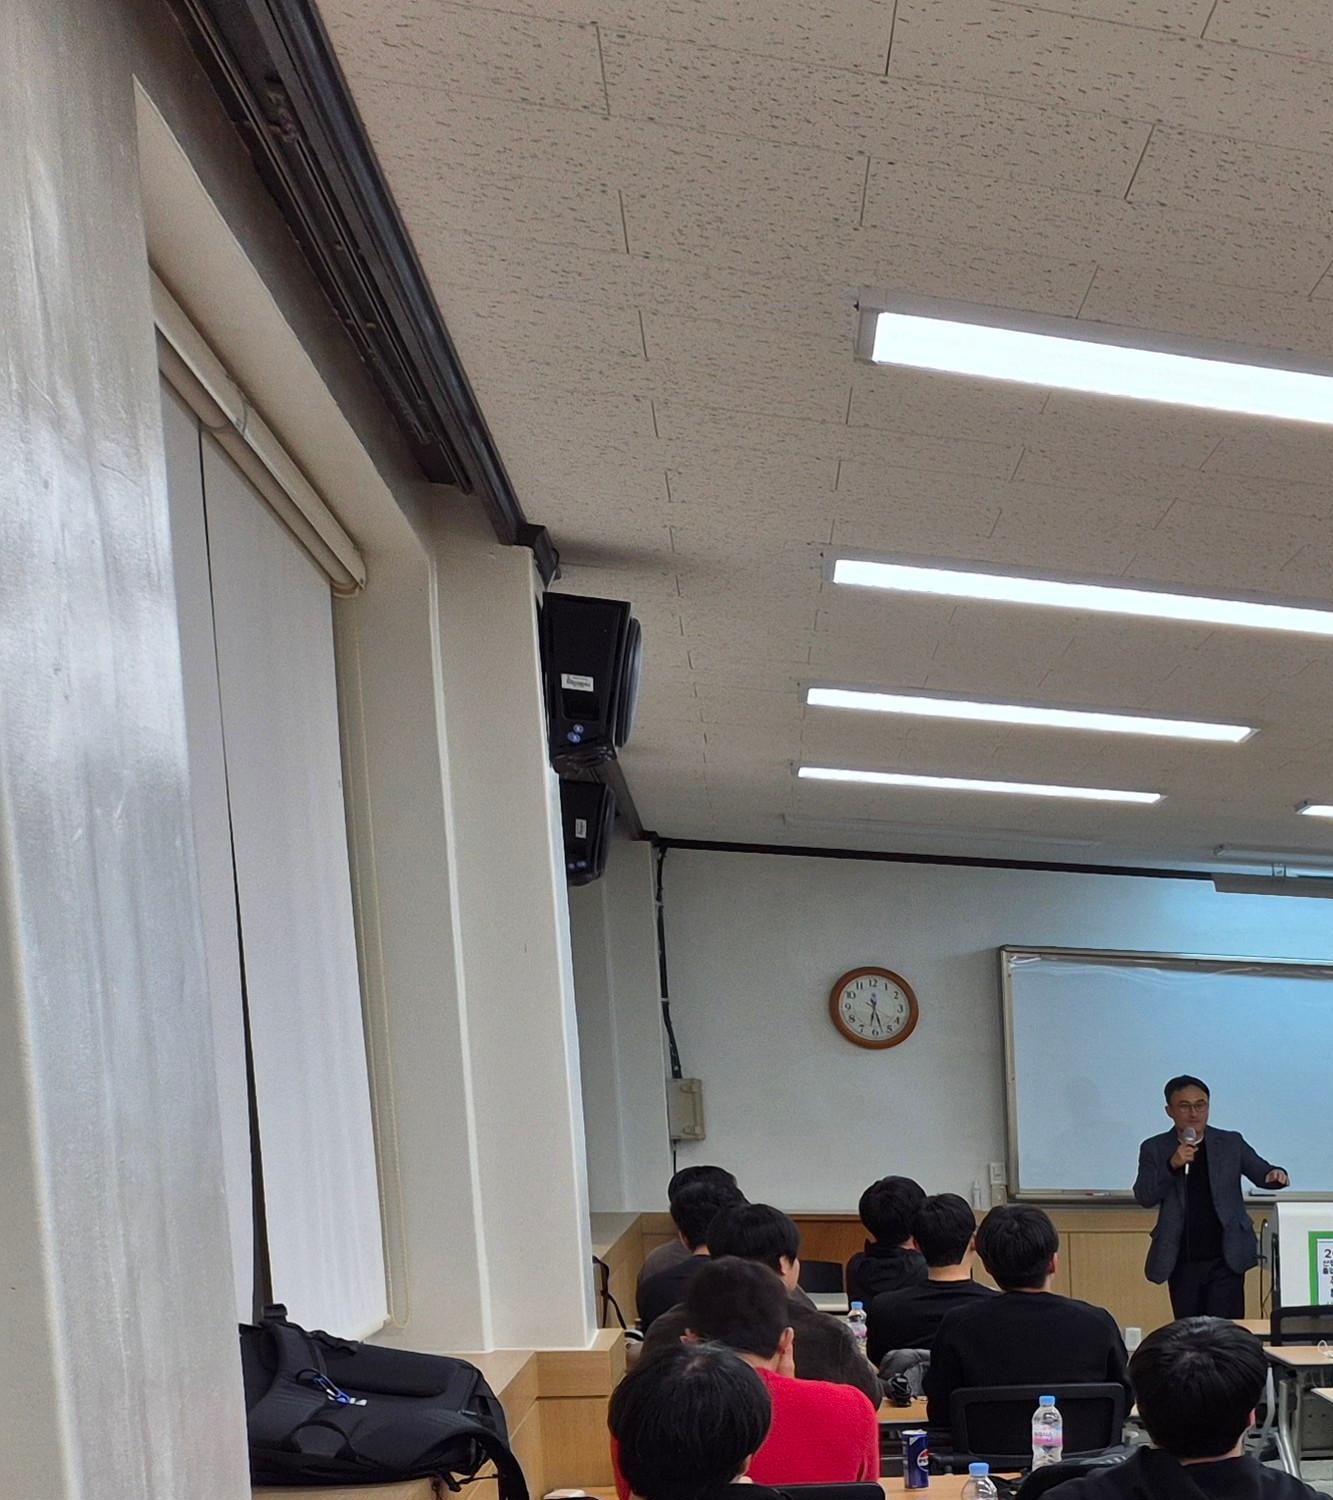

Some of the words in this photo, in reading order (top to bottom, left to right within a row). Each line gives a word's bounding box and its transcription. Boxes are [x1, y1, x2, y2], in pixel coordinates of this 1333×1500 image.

[856, 981, 863, 990] 11
[869, 979, 878, 987] 12
[884, 982, 888, 991] 1
[846, 991, 856, 999] 10
[893, 991, 899, 999] 2
[897, 1004, 903, 1013] 3
[848, 1015, 856, 1024] 8
[859, 1024, 865, 1033] 7
[886, 1025, 893, 1033] 5
